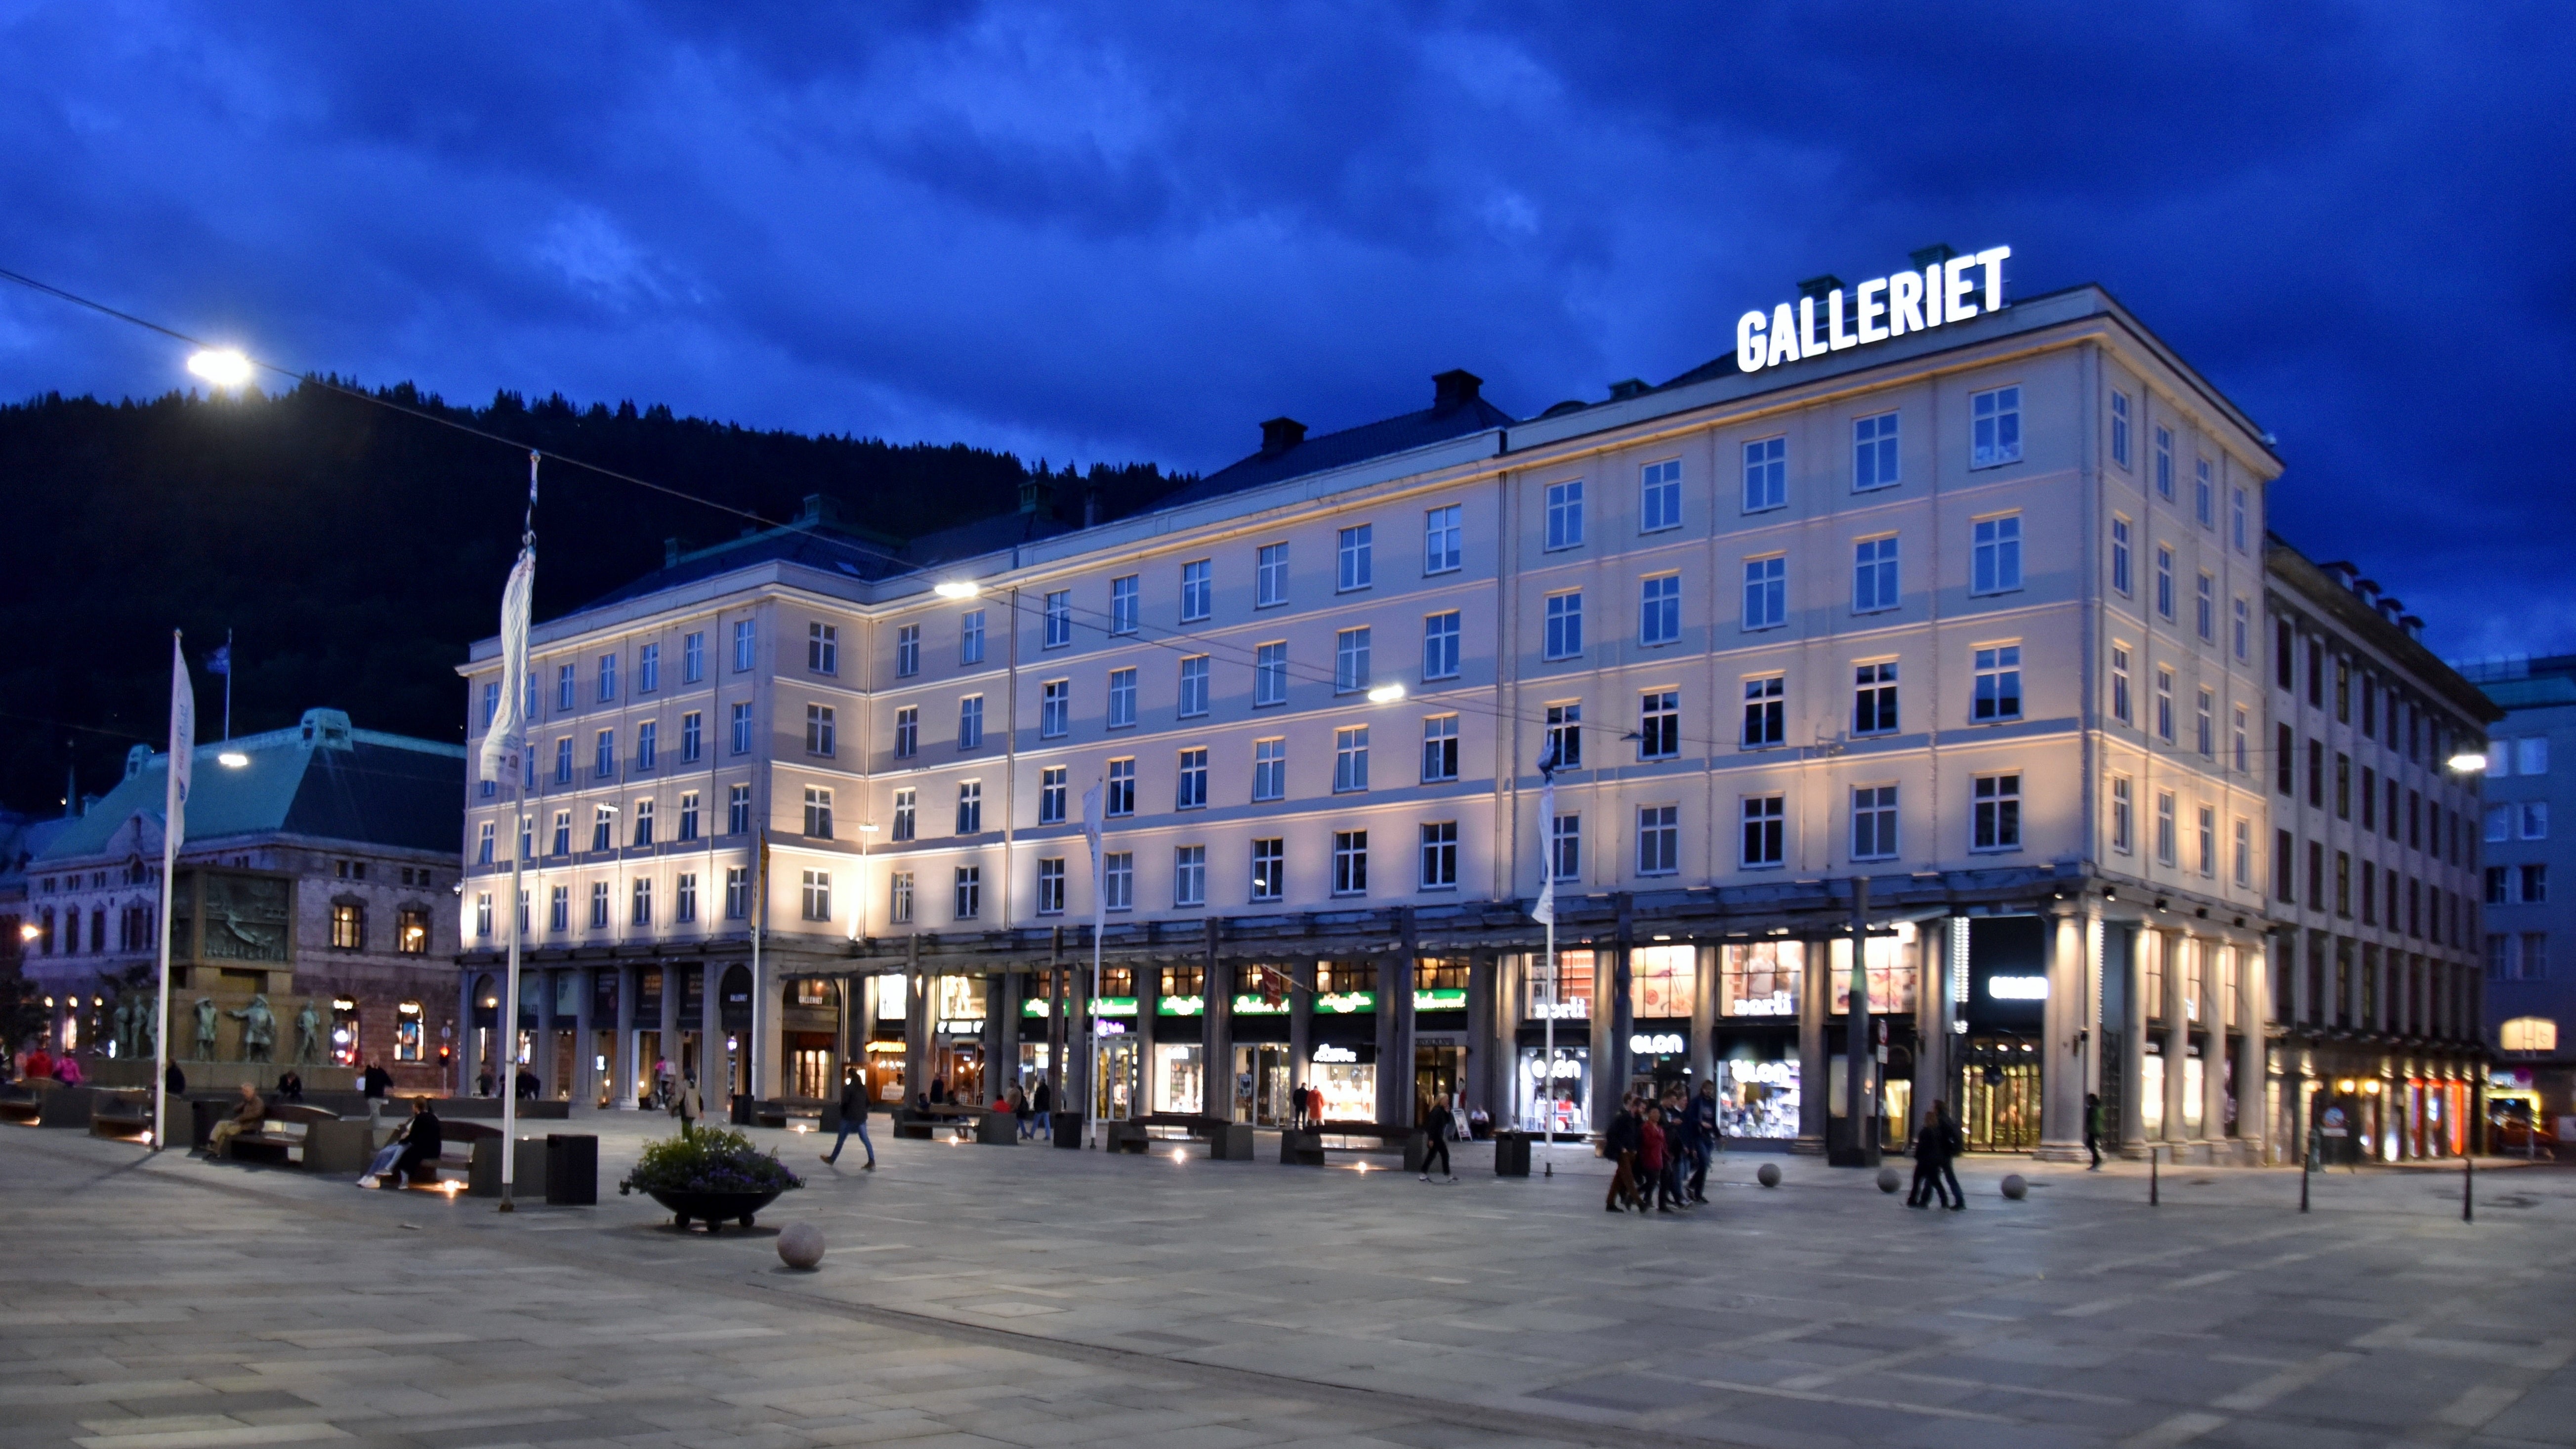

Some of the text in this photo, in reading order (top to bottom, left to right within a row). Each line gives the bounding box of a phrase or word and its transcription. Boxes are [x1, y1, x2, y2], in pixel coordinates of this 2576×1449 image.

[1737, 246, 2010, 373] GALLERIET
[799, 995, 823, 1004] GALLERIET
[1535, 996, 1586, 1018] norli
[1733, 991, 1792, 1015] norli
